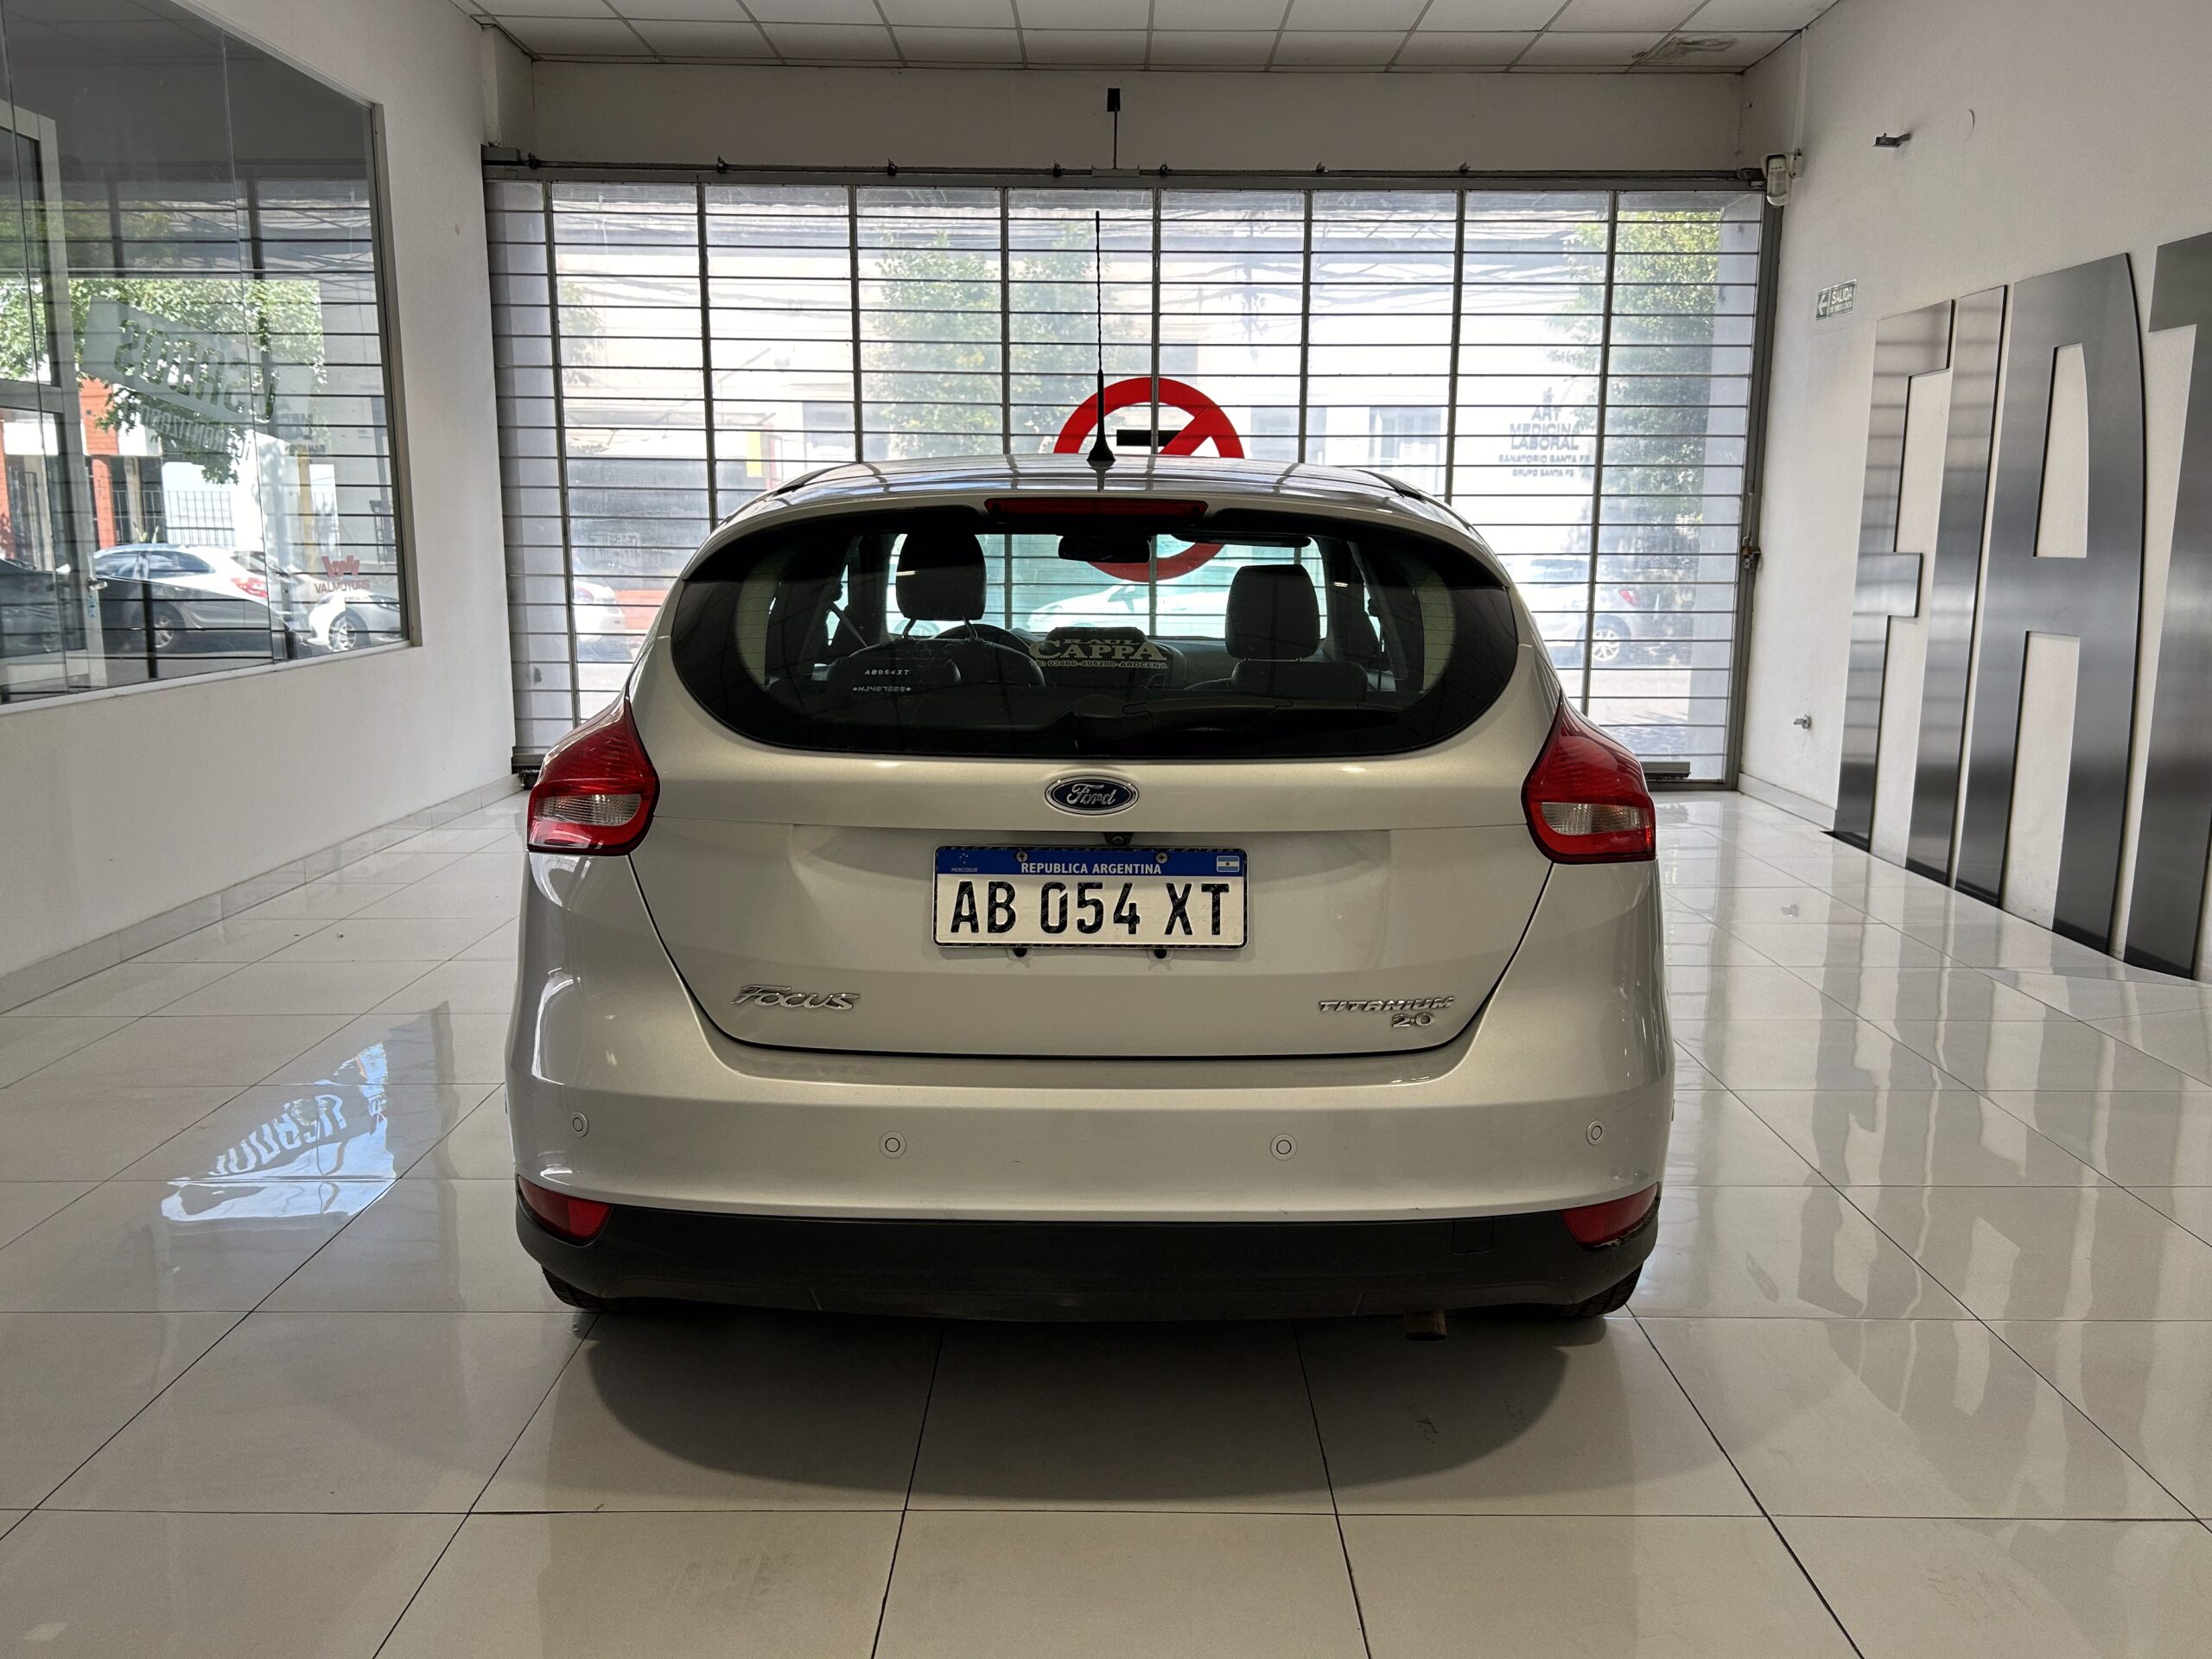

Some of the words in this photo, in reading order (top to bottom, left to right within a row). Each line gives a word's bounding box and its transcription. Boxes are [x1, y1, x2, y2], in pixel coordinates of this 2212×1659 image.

[1832, 286, 1853, 304] SALIDA
[1510, 423, 1580, 435] MEDICINA
[1511, 435, 1580, 450] LABORAL
[1498, 454, 1548, 463] SANATORIO
[315, 580, 370, 594] VALMOTORS
[1028, 639, 1167, 661] CAPPA
[1066, 783, 1117, 804] Ford
[1020, 862, 1088, 874] REPUBLICA
[1092, 864, 1161, 874] ARGENTINA
[950, 880, 1016, 934] AB
[1039, 881, 1141, 935] 054
[1163, 882, 1230, 935] XT
[1319, 995, 1455, 1012] TITANIUM
